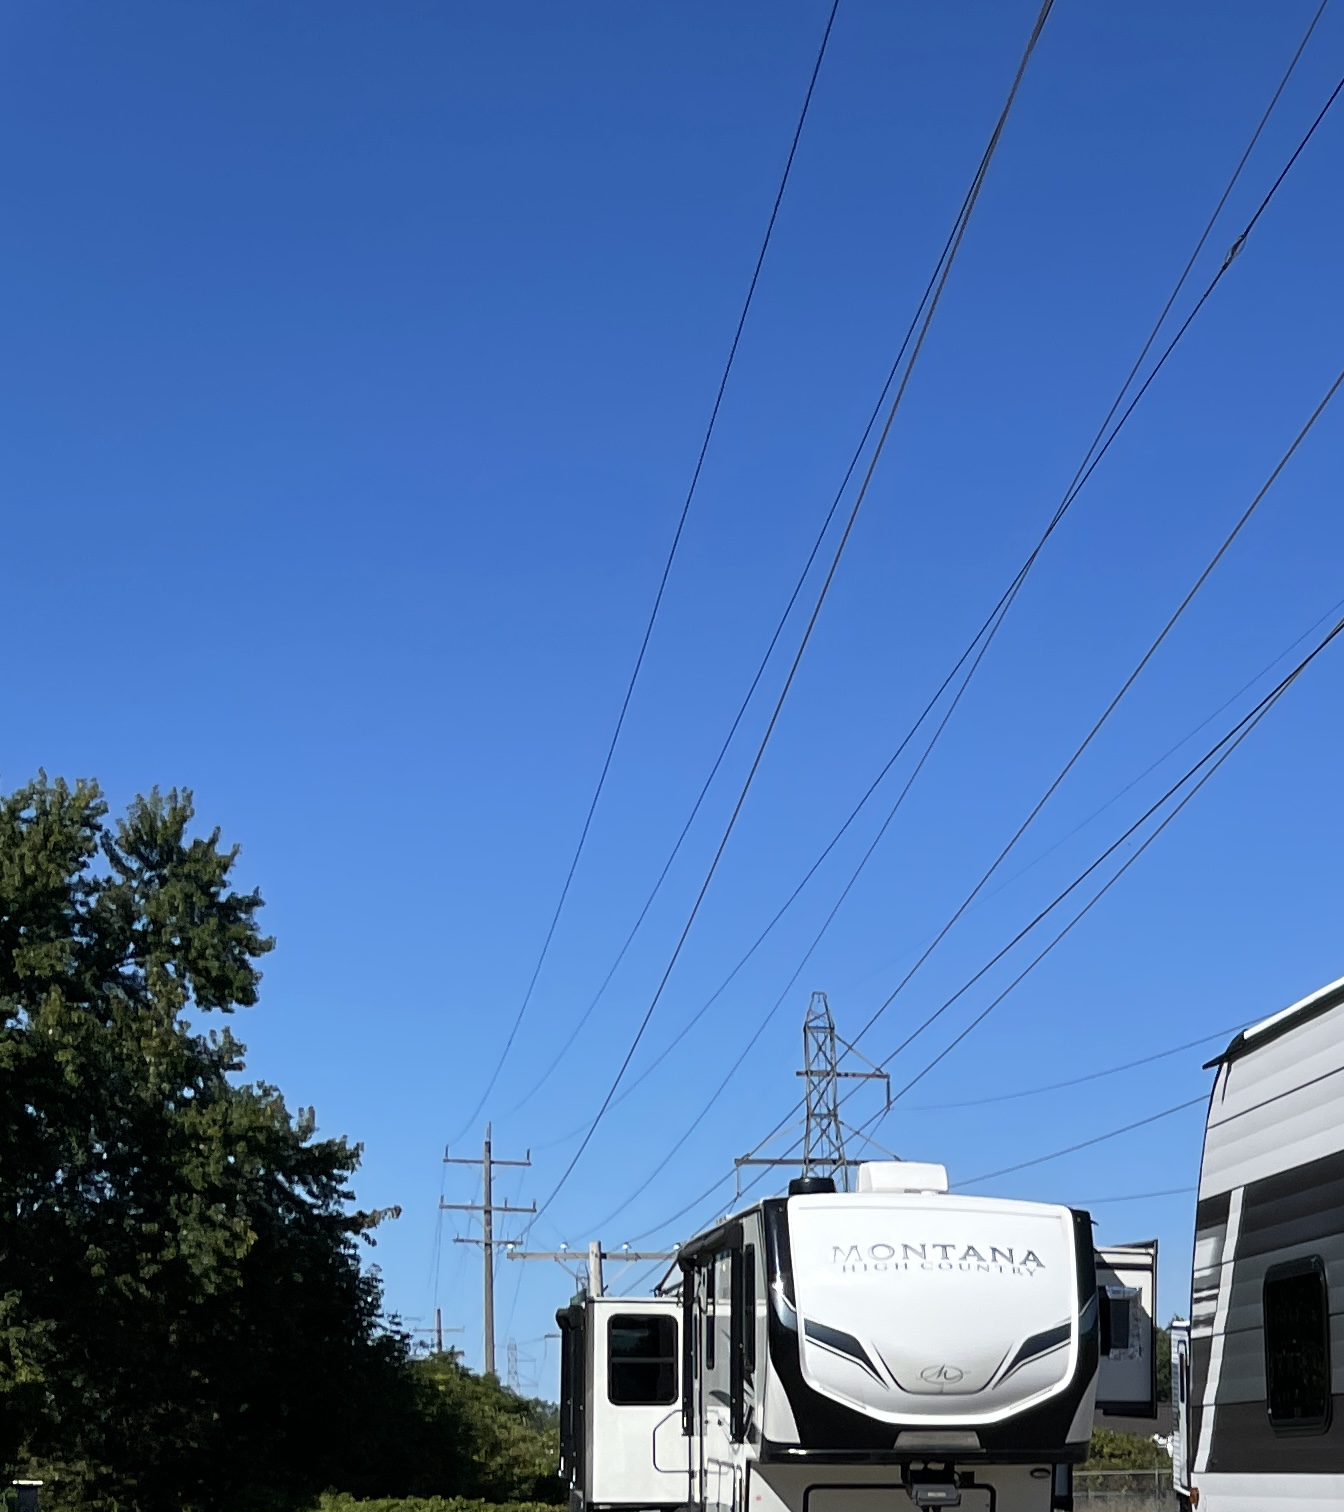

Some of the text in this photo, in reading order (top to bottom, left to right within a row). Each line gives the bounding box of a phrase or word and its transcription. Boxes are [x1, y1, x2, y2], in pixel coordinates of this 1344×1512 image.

[832, 1243, 1046, 1269] MONTANA
[842, 1261, 1037, 1277] HIGH COUNTRY
